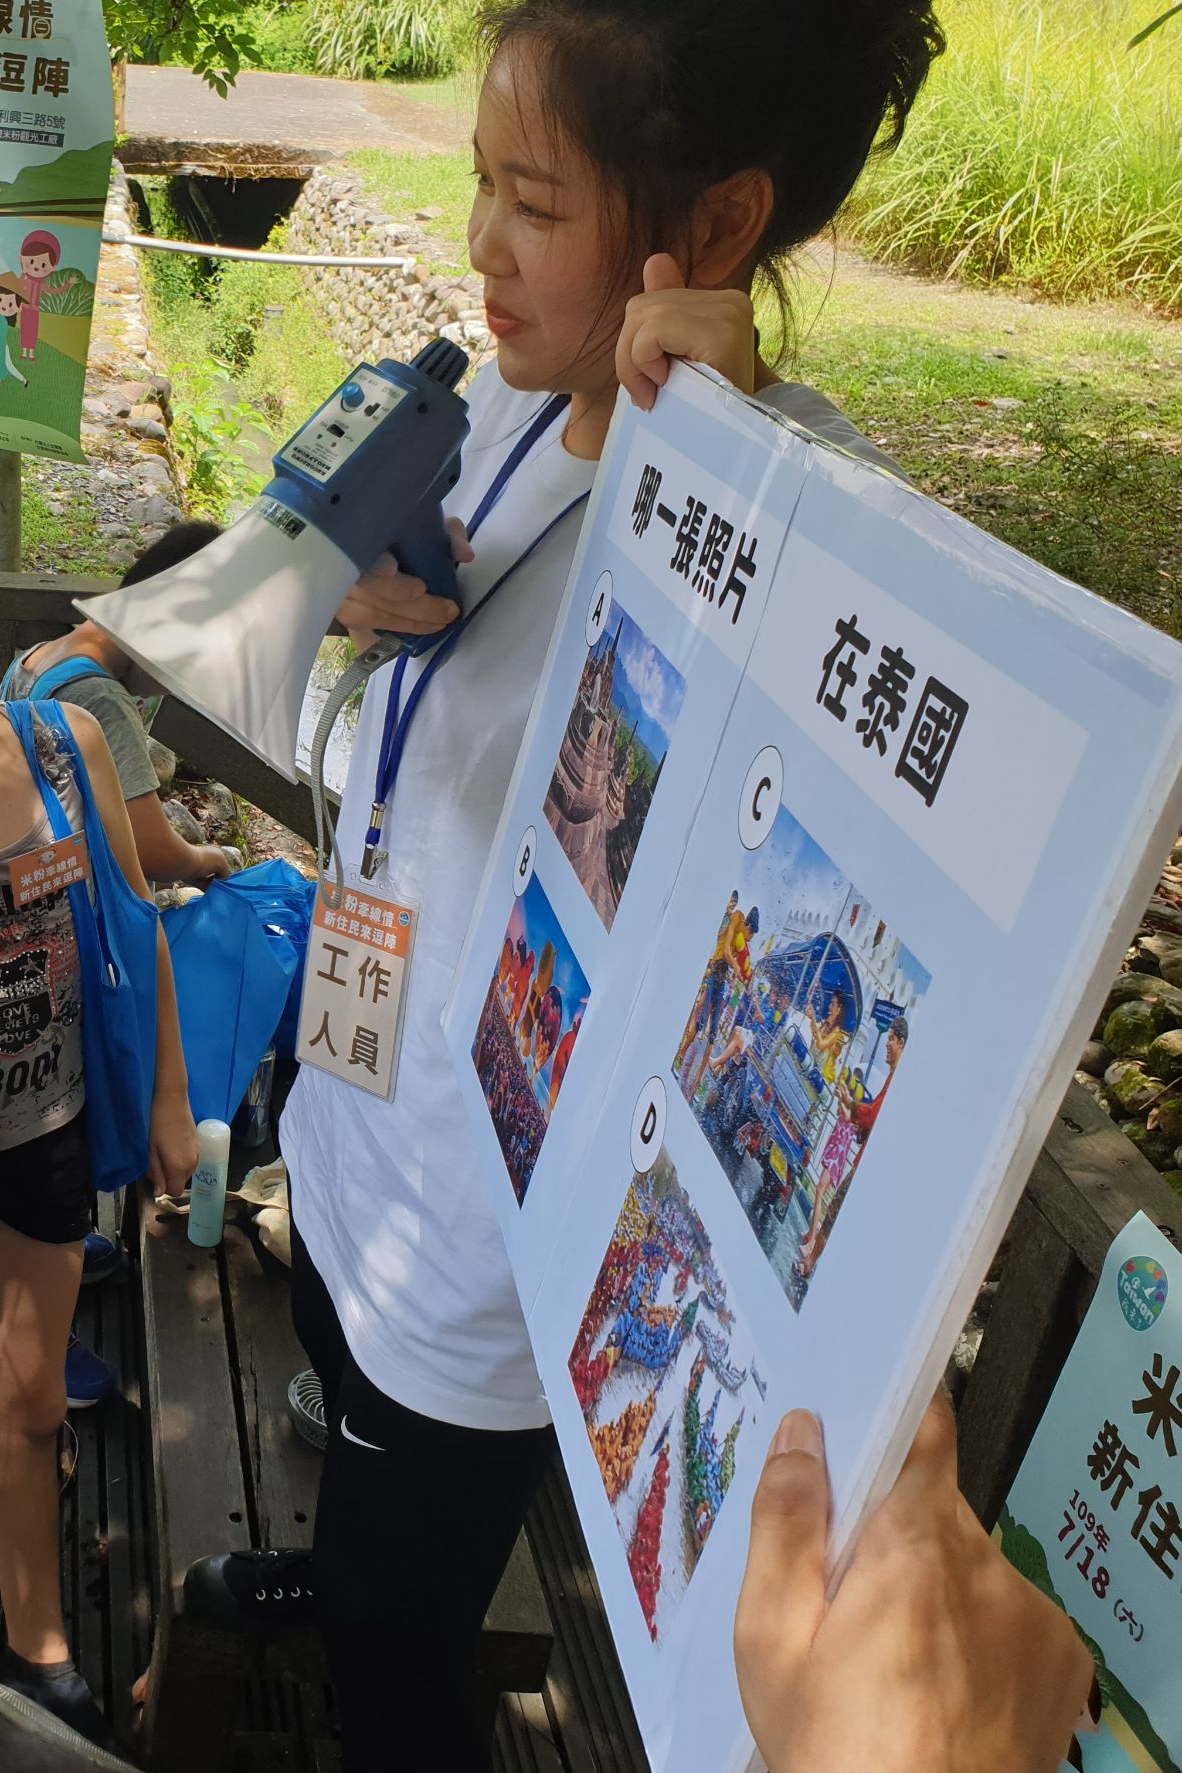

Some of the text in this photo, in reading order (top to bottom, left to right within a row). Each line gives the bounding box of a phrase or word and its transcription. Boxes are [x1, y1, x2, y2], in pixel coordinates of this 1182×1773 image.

[631, 464, 758, 625] 哪一張照片
[591, 592, 605, 627] A
[816, 614, 969, 808] 在泰國
[752, 776, 772, 822] C
[519, 844, 531, 878] B
[324, 911, 397, 950] 新住民來逗陣
[332, 891, 395, 928] 粉牽線情
[317, 942, 391, 1004] 工作
[308, 1010, 379, 1076] 人員
[640, 1101, 657, 1145] D
[1132, 1353, 1182, 1457] 米
[1069, 1488, 1111, 1555] 109年
[1057, 1511, 1108, 1600] 7/18
